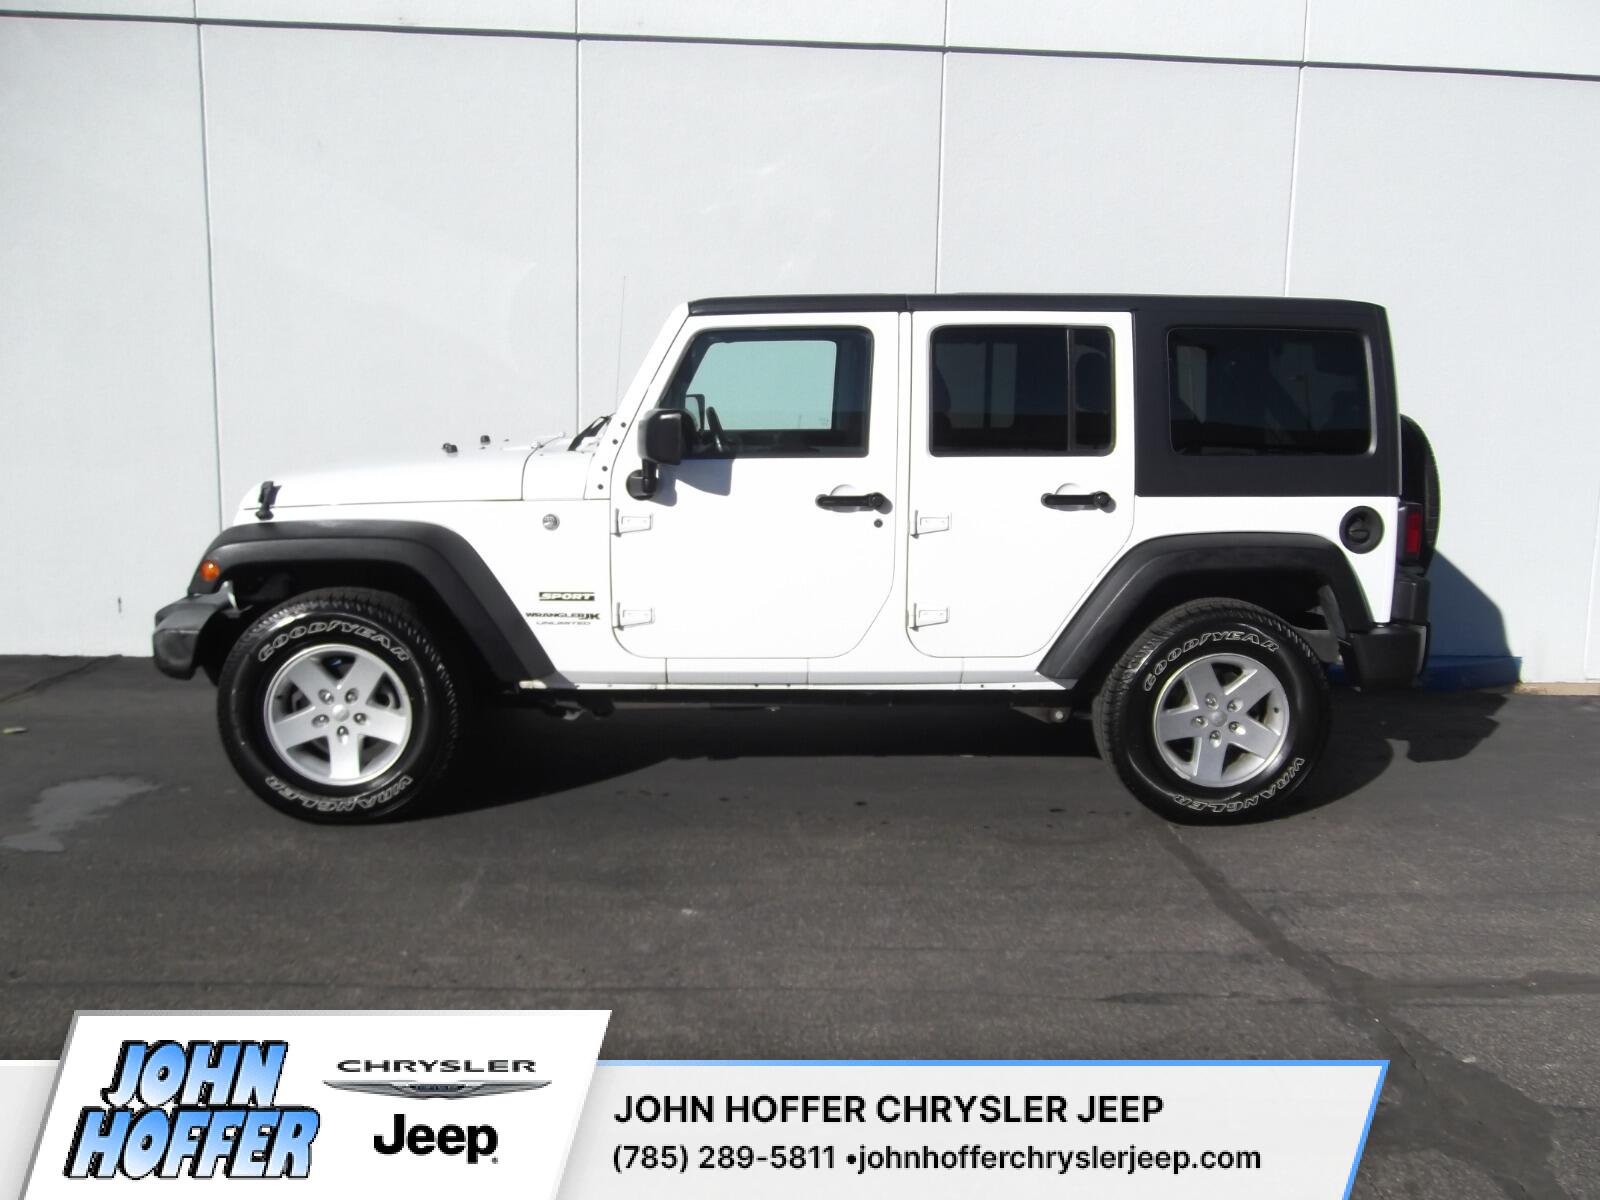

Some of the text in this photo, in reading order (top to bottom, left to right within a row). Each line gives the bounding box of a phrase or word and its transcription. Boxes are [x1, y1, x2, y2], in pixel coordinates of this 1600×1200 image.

[540, 592, 593, 600] SPORT
[258, 619, 410, 662] GOODYEAR
[1143, 630, 1280, 692] GOODYEAR
[265, 774, 414, 812] WRANGLER
[1173, 757, 1305, 812] WRANGLER
